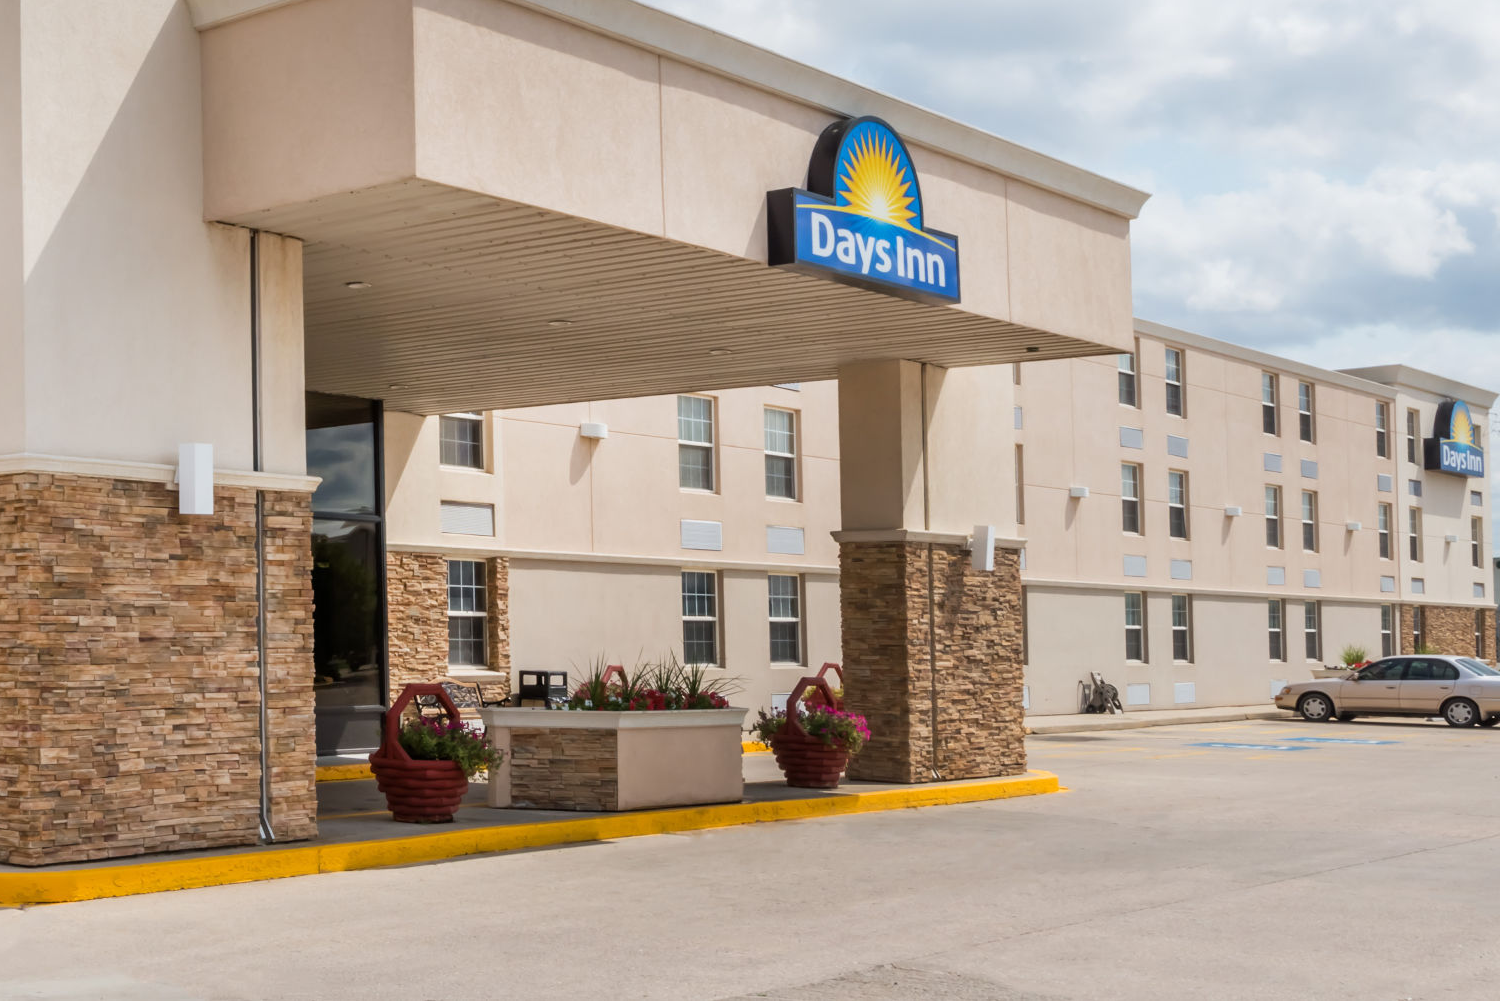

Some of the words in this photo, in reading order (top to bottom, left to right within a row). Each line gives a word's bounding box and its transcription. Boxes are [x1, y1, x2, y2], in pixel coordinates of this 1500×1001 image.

[811, 212, 892, 275] Days
[896, 235, 946, 288] Inn
[1443, 445, 1466, 471] Days
[1467, 450, 1482, 472] Inn
